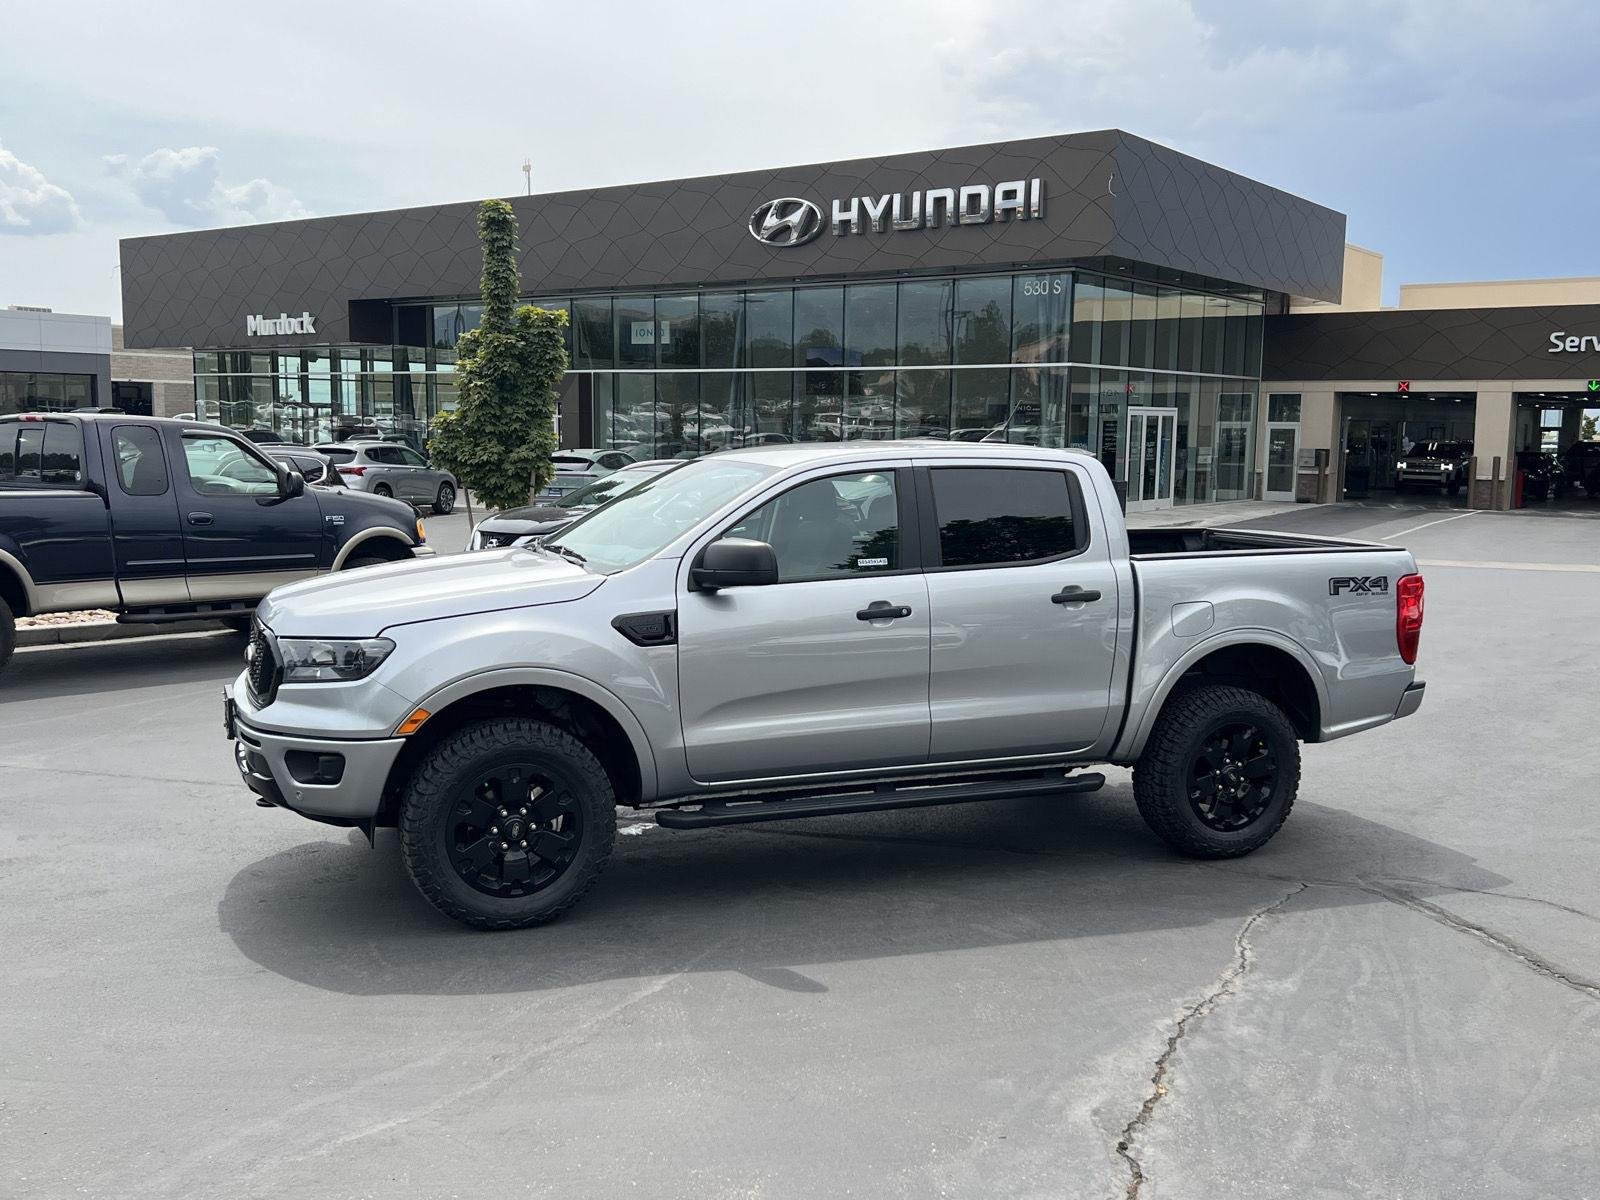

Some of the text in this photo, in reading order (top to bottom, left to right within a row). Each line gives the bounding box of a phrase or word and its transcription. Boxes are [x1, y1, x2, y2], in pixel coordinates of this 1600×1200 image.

[831, 178, 1044, 236] HYUNDAI
[1024, 279, 1061, 296] 530 S
[246, 311, 316, 337] Murdock
[1328, 576, 1389, 596] FX4
